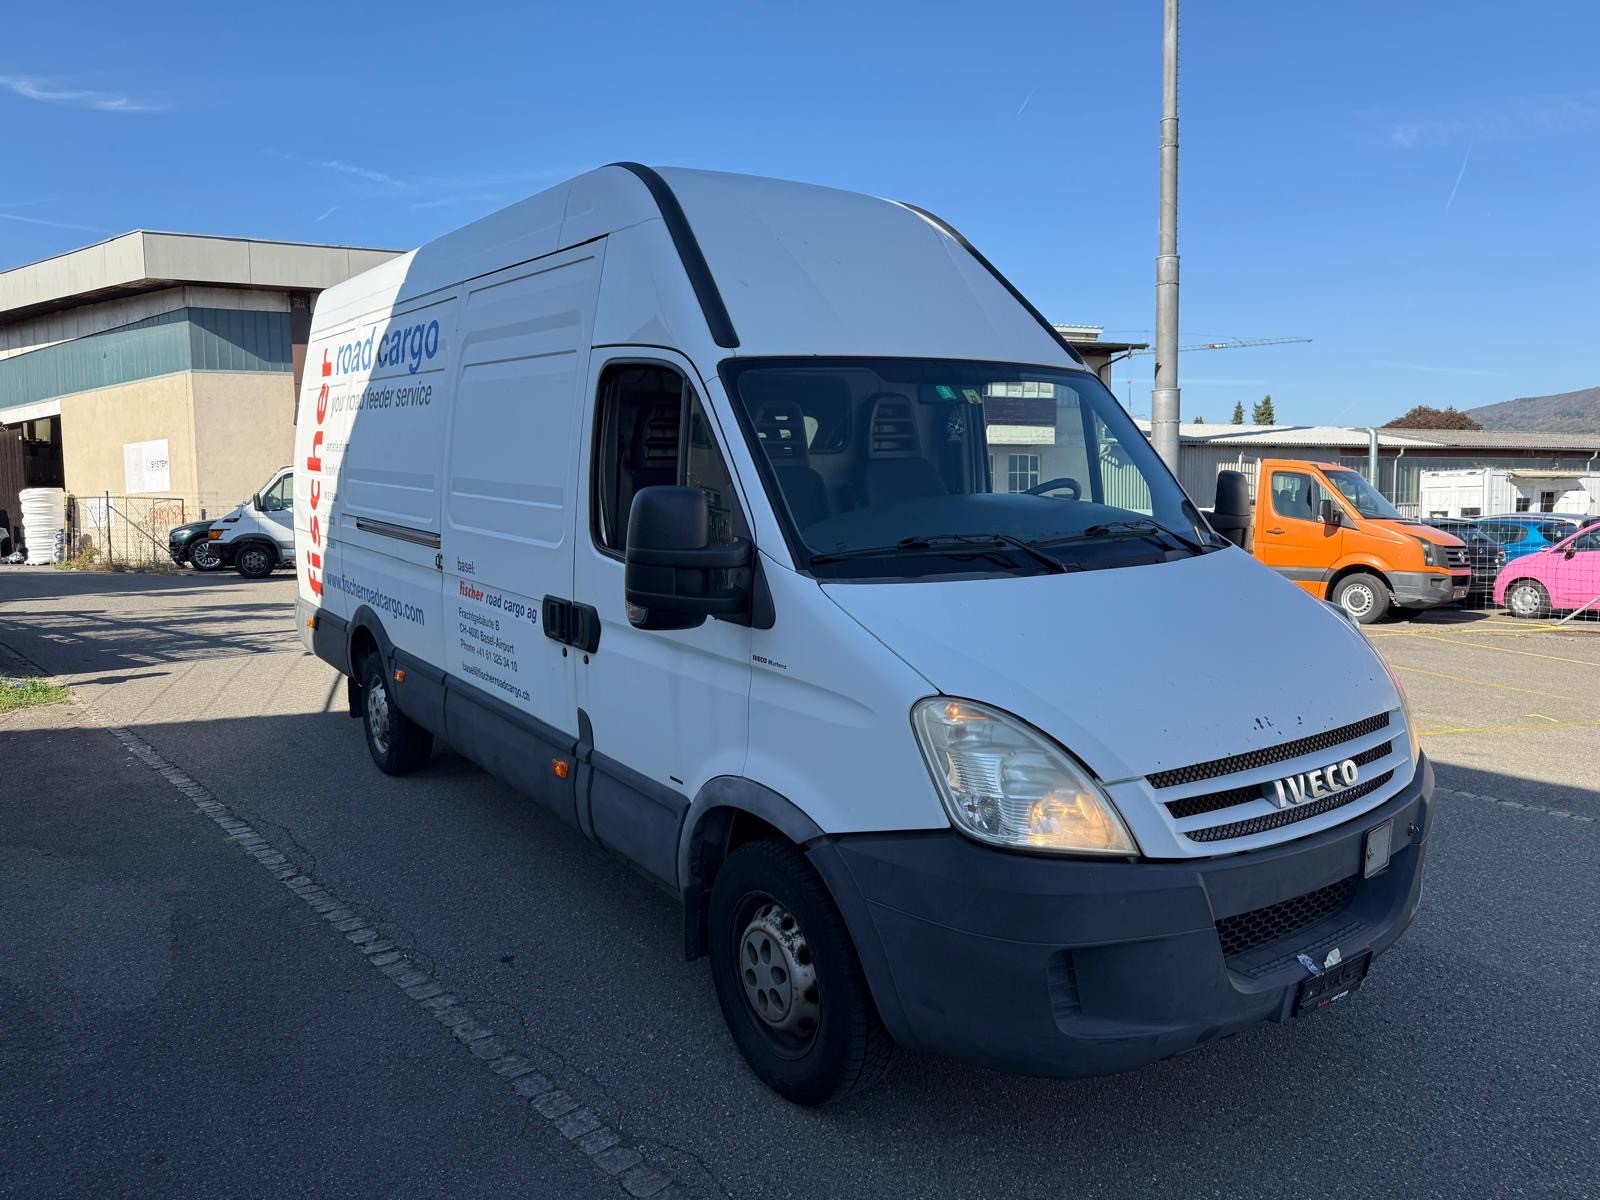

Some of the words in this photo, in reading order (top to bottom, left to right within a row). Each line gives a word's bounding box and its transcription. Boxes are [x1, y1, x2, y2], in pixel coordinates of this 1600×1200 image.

[336, 327, 376, 376] road
[378, 320, 440, 375] cargo
[331, 394, 346, 417] your
[346, 387, 364, 411] road
[365, 384, 394, 409] feeder
[395, 380, 432, 406] service
[457, 557, 476, 575] basel:
[326, 571, 425, 626] www.fischerroadcargo.com
[459, 580, 484, 602] fischer
[485, 594, 502, 609] road
[503, 600, 525, 619] cargo
[527, 607, 538, 624] ag
[495, 620, 500, 631] B
[460, 638, 475, 654] Phone
[511, 661, 518, 673] 10
[1273, 759, 1359, 809] IVECO
